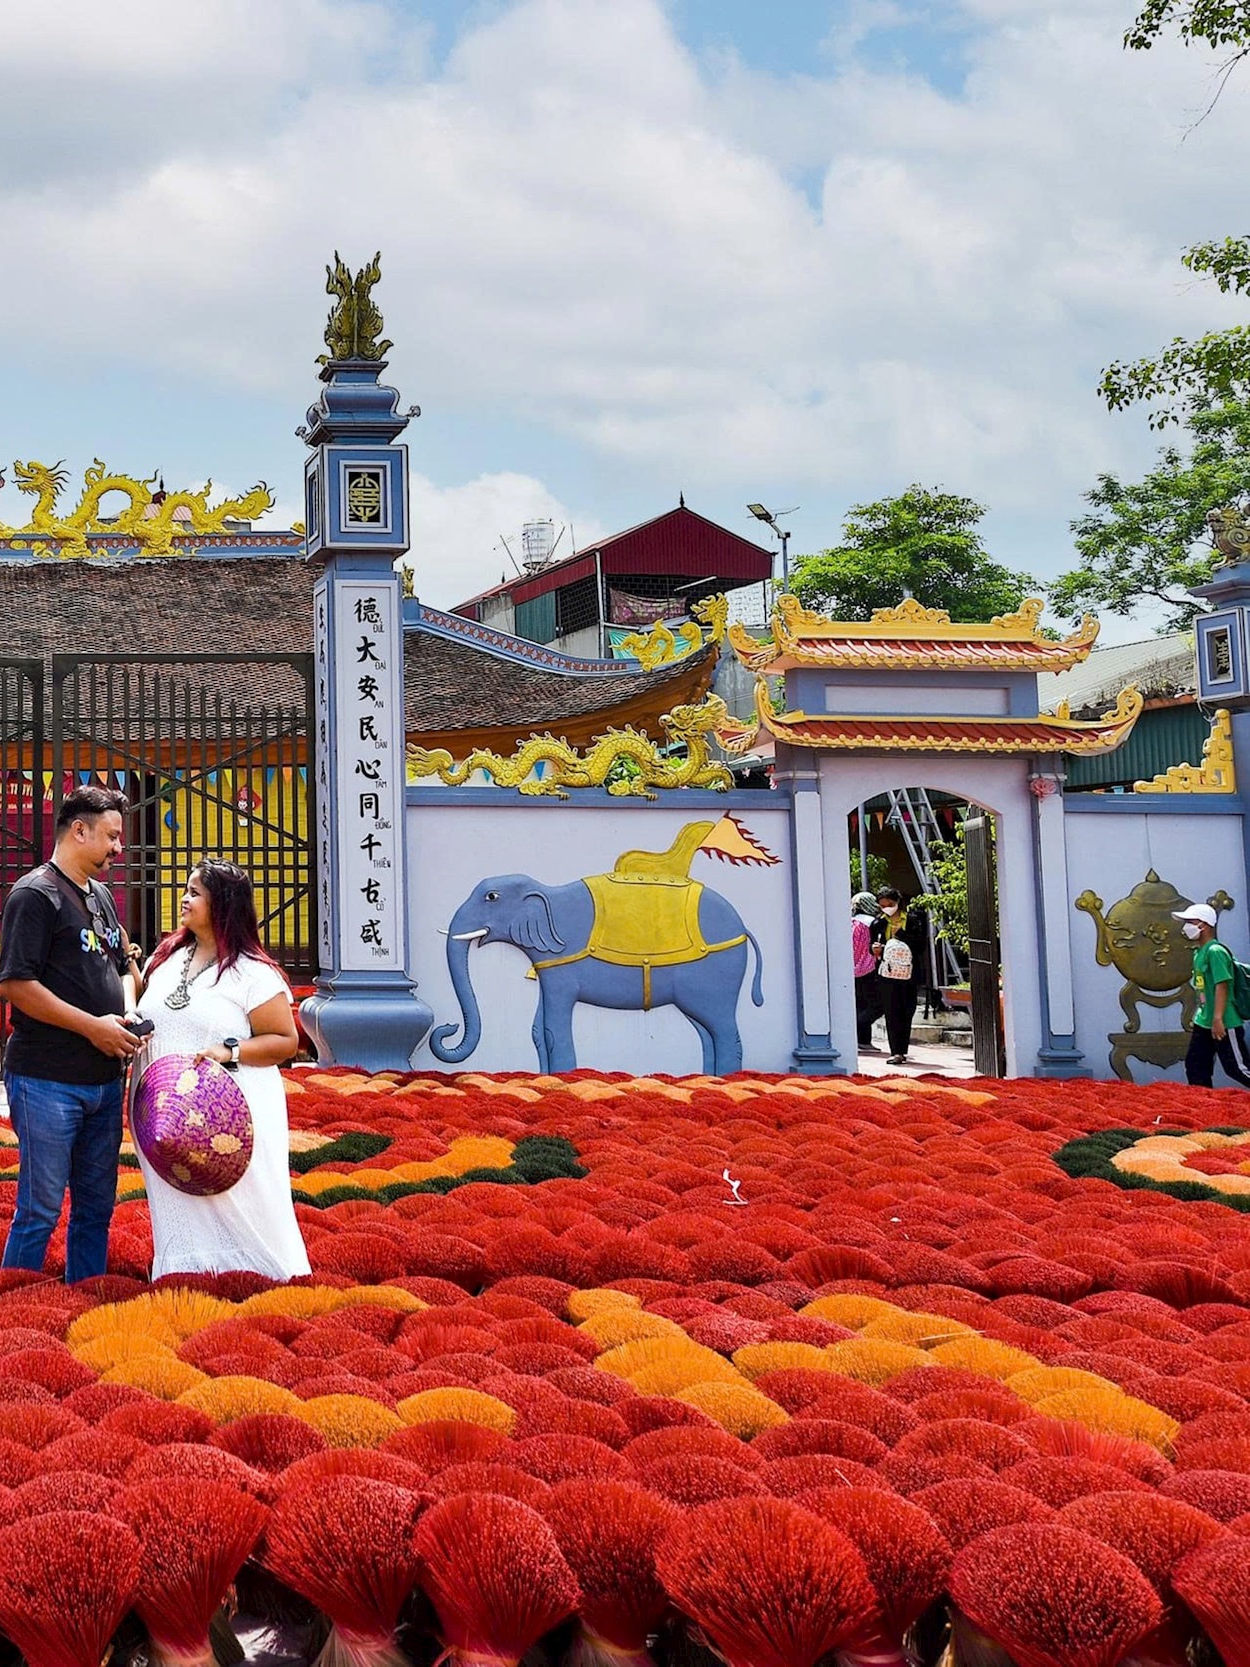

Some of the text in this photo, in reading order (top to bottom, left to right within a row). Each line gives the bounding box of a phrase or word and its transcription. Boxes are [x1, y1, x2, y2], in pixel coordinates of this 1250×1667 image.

[374, 700, 384, 708] AN
[375, 739, 388, 749] DÂN
[375, 778, 387, 788] TÂM
[373, 857, 391, 868] THIÊN
